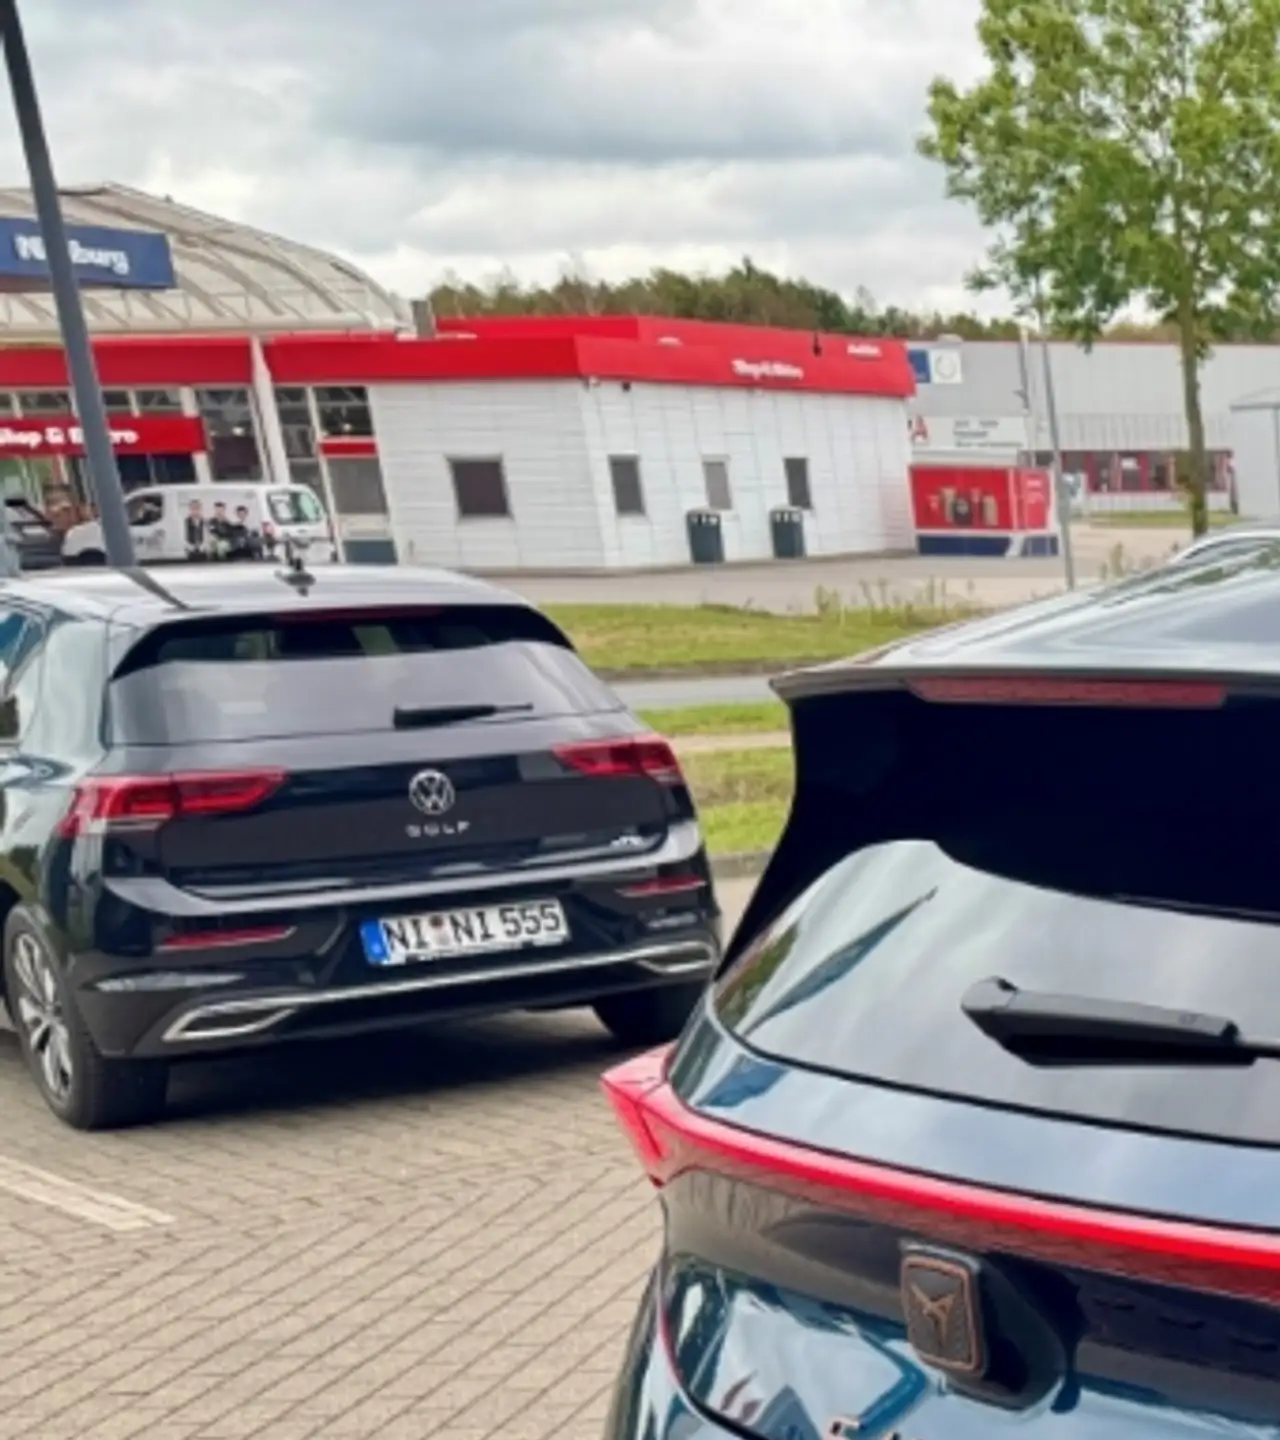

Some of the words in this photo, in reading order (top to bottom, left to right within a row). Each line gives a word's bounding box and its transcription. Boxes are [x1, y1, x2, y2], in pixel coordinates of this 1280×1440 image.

[405, 820, 470, 838] GOLF
[384, 919, 428, 951] NI
[450, 911, 496, 942] NI
[500, 903, 561, 936] 555
